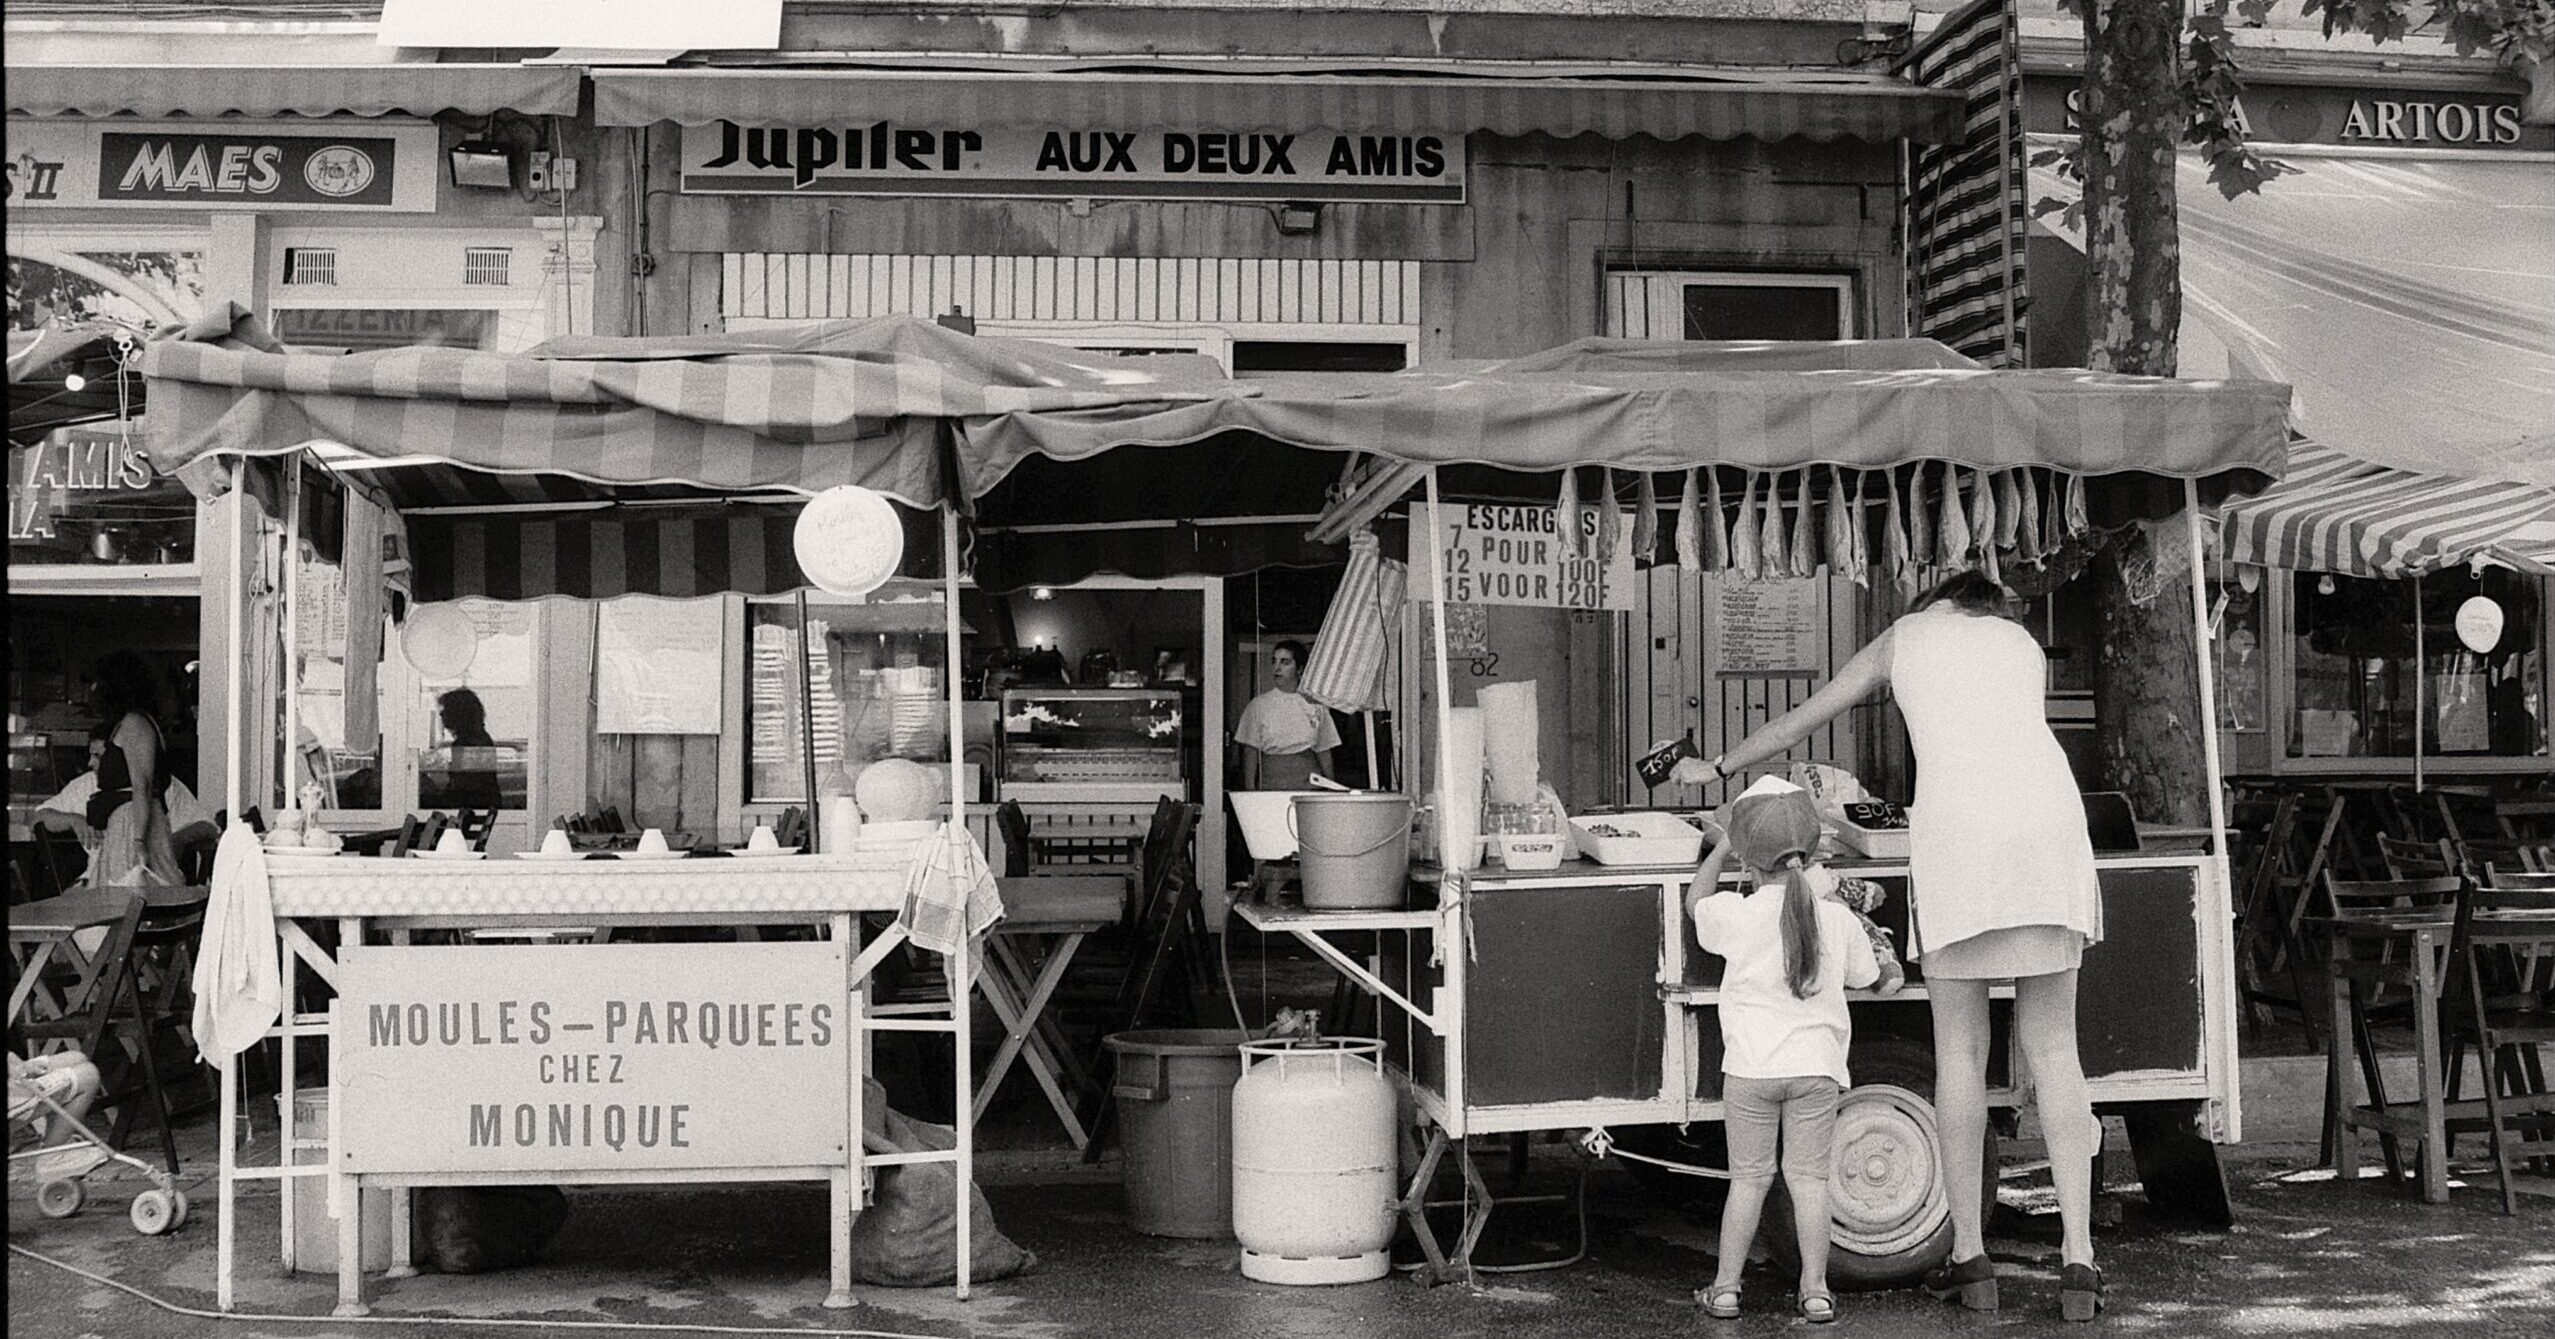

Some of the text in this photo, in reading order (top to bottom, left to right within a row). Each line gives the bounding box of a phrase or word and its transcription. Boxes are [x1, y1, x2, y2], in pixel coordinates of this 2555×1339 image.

[2341, 100, 2522, 143] ARTOIS
[119, 141, 282, 193] MAES
[701, 119, 1445, 188] Jupiler AUX DEUX AMIS
[27, 441, 152, 489] AMIS
[1450, 525, 1462, 548] 7
[1467, 505, 1596, 536] ESCARGS
[1445, 549, 1470, 574] 12
[1482, 536, 1547, 565] POUR
[1557, 558, 1609, 584] 100F
[1445, 572, 1610, 608] 15 VOOR 120F
[1471, 652, 1499, 677] 82
[1855, 803, 1896, 819] 90F
[540, 1054, 625, 1084] CHEZ
[469, 1103, 691, 1151] MONIQUE
